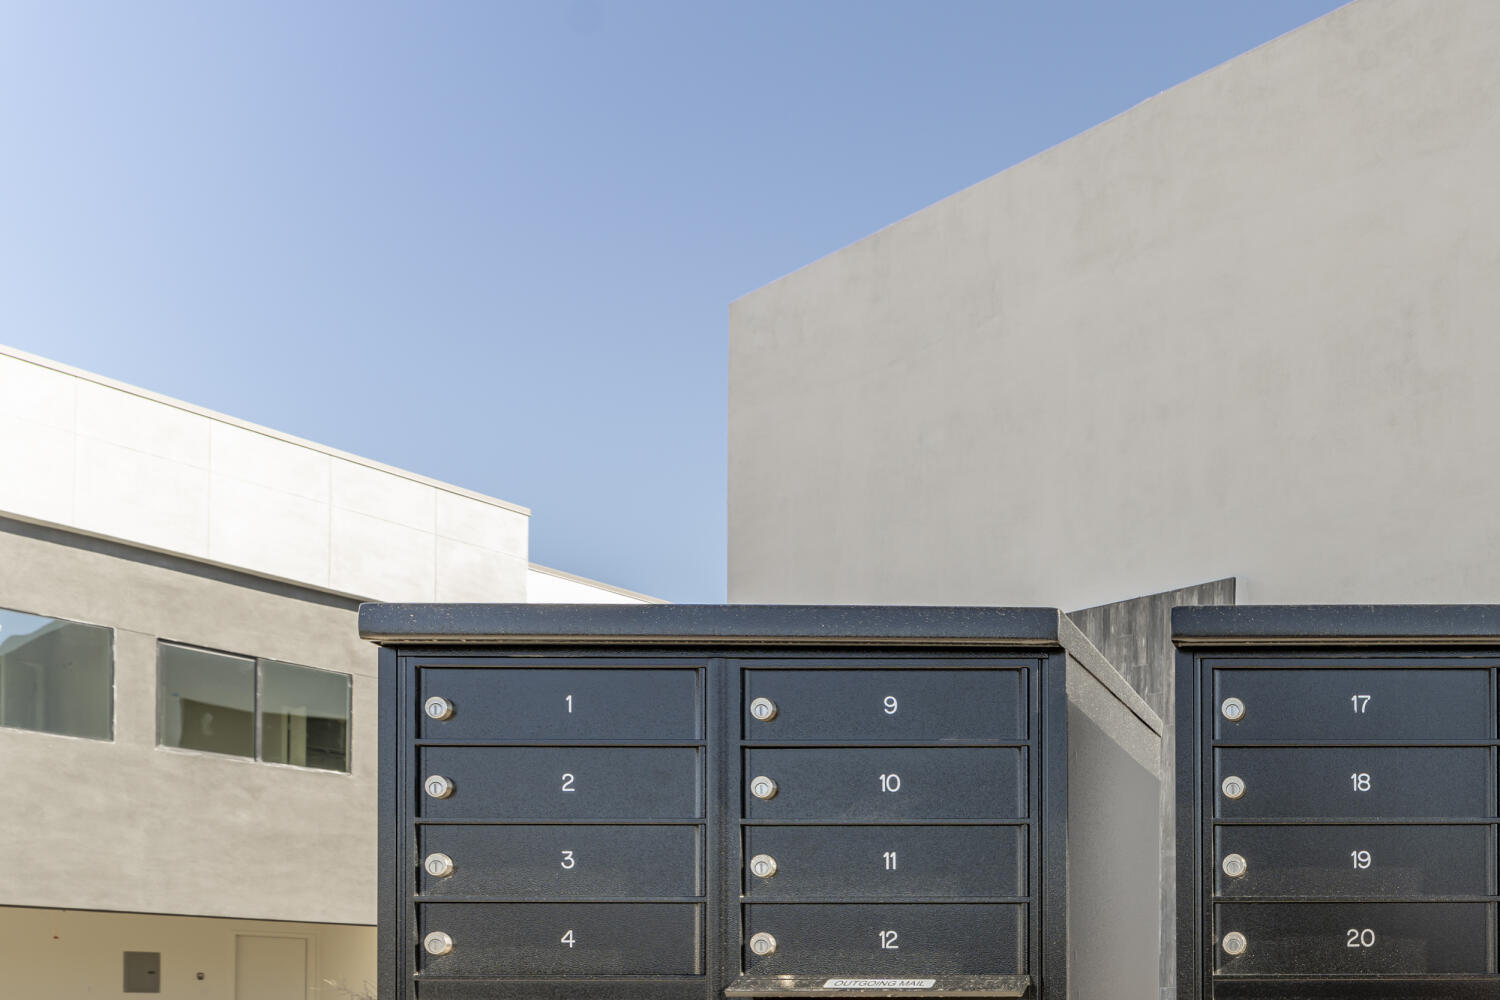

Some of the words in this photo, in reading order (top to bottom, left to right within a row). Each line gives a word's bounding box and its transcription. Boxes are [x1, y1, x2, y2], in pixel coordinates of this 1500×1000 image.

[565, 694, 572, 713] 1
[883, 695, 898, 715] 9
[1351, 694, 1371, 714] 17
[561, 773, 576, 792] 2
[879, 773, 901, 793] 10
[1350, 772, 1371, 792] 18
[560, 850, 575, 870] 3
[882, 851, 897, 870] 11
[1350, 850, 1372, 869] 19
[560, 929, 576, 948] 4
[878, 930, 899, 949] 12
[1346, 928, 1376, 948] 20
